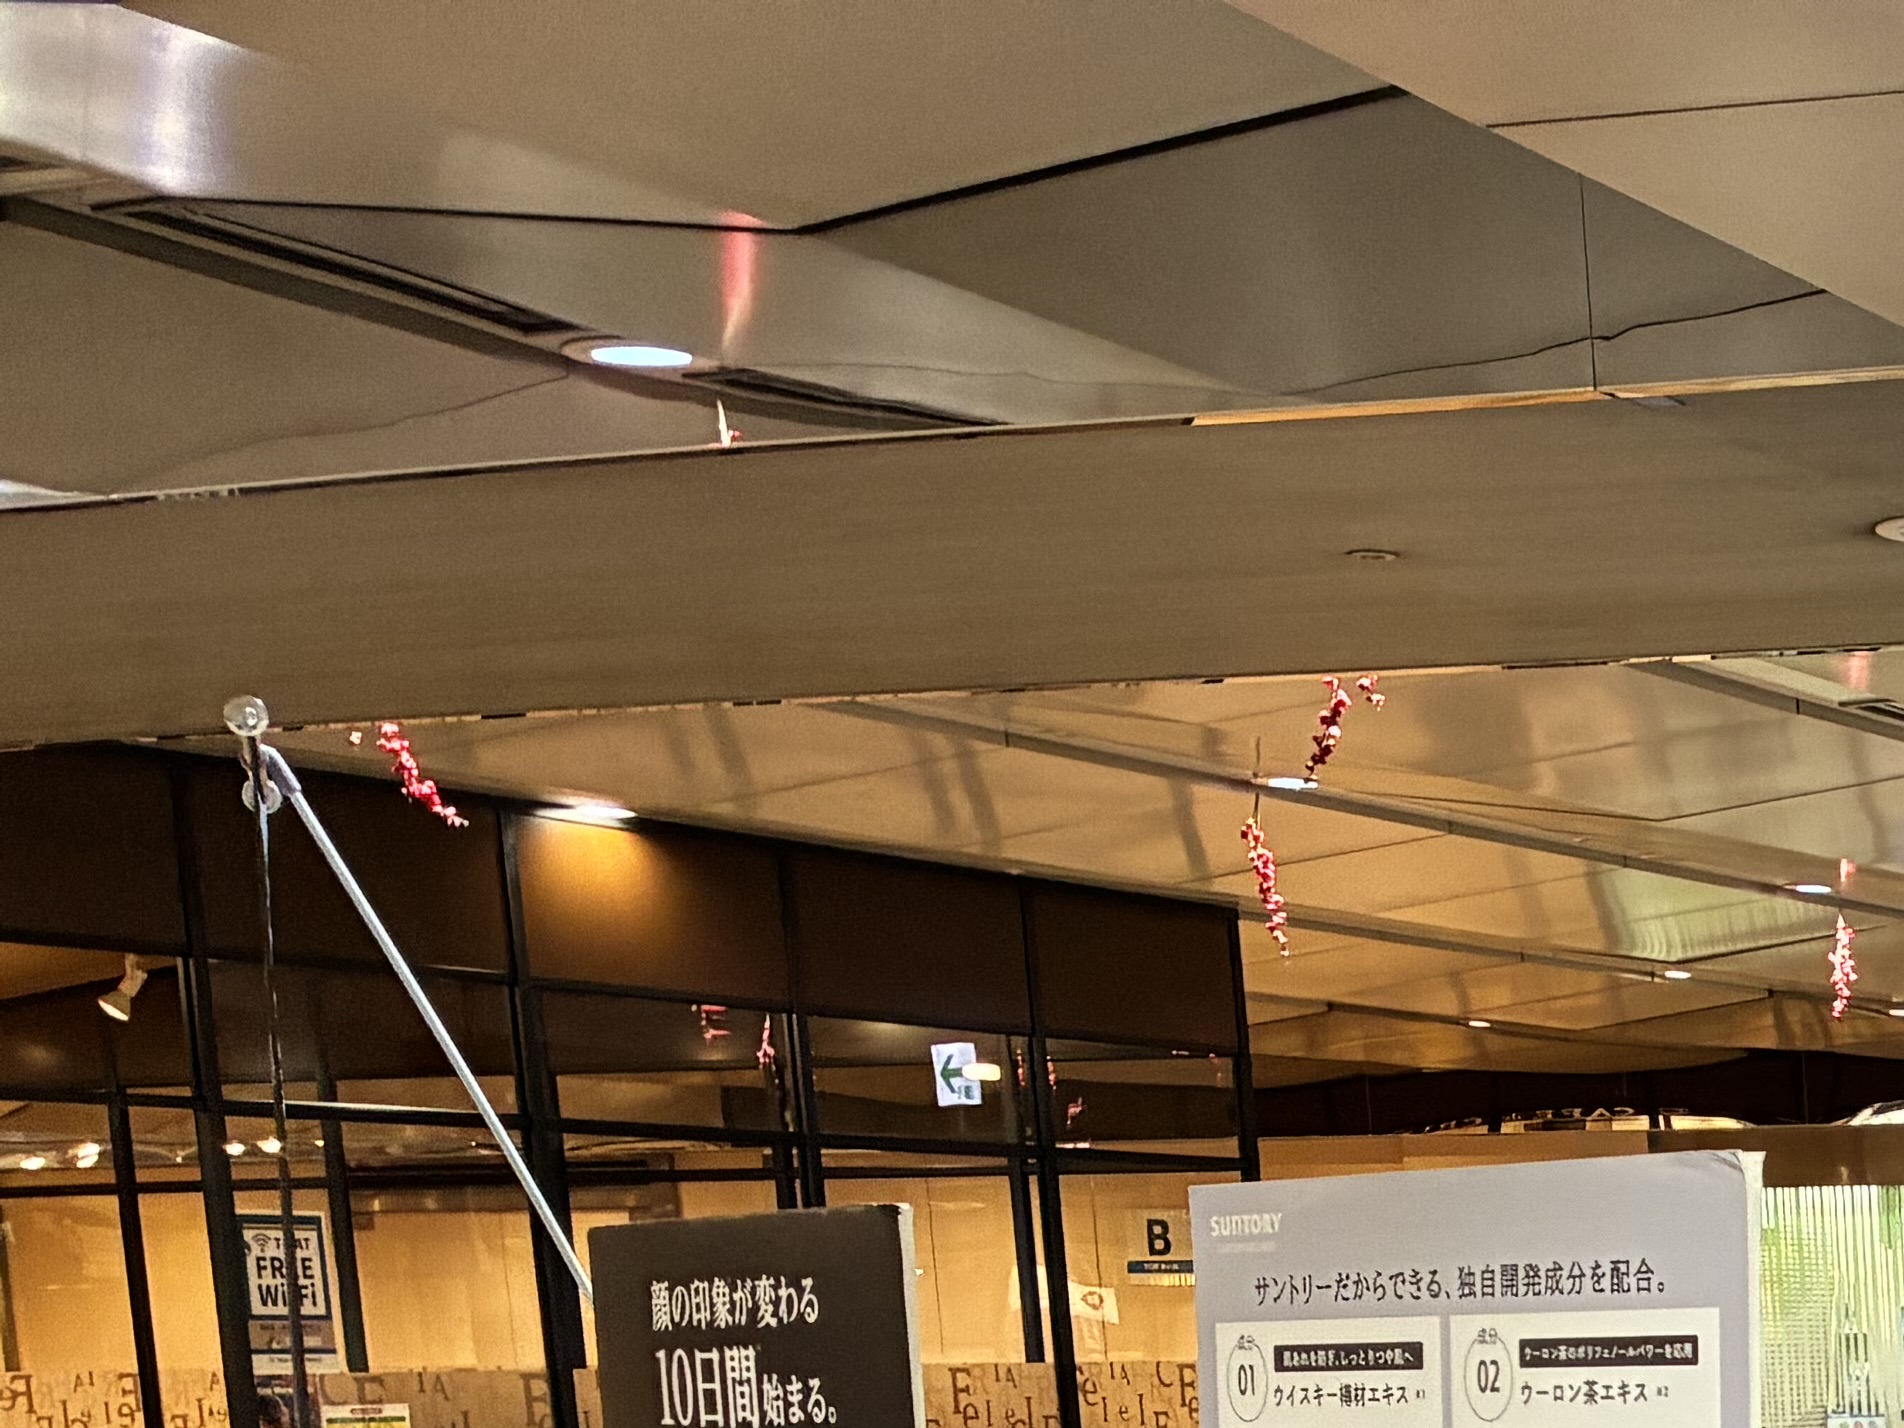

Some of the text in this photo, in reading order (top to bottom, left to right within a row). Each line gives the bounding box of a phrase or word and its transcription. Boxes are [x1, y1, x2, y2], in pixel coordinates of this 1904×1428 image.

[1146, 1218, 1172, 1257] B
[1210, 1212, 1283, 1237] SUNTORY
[1254, 1257, 1667, 1307] サントリーだからできる、独自開発成分を配合。
[650, 1274, 819, 1331] 顔の印象が変わる
[1477, 1360, 1500, 1394] 02
[1521, 1380, 1648, 1405] ウーロン茶エキス
